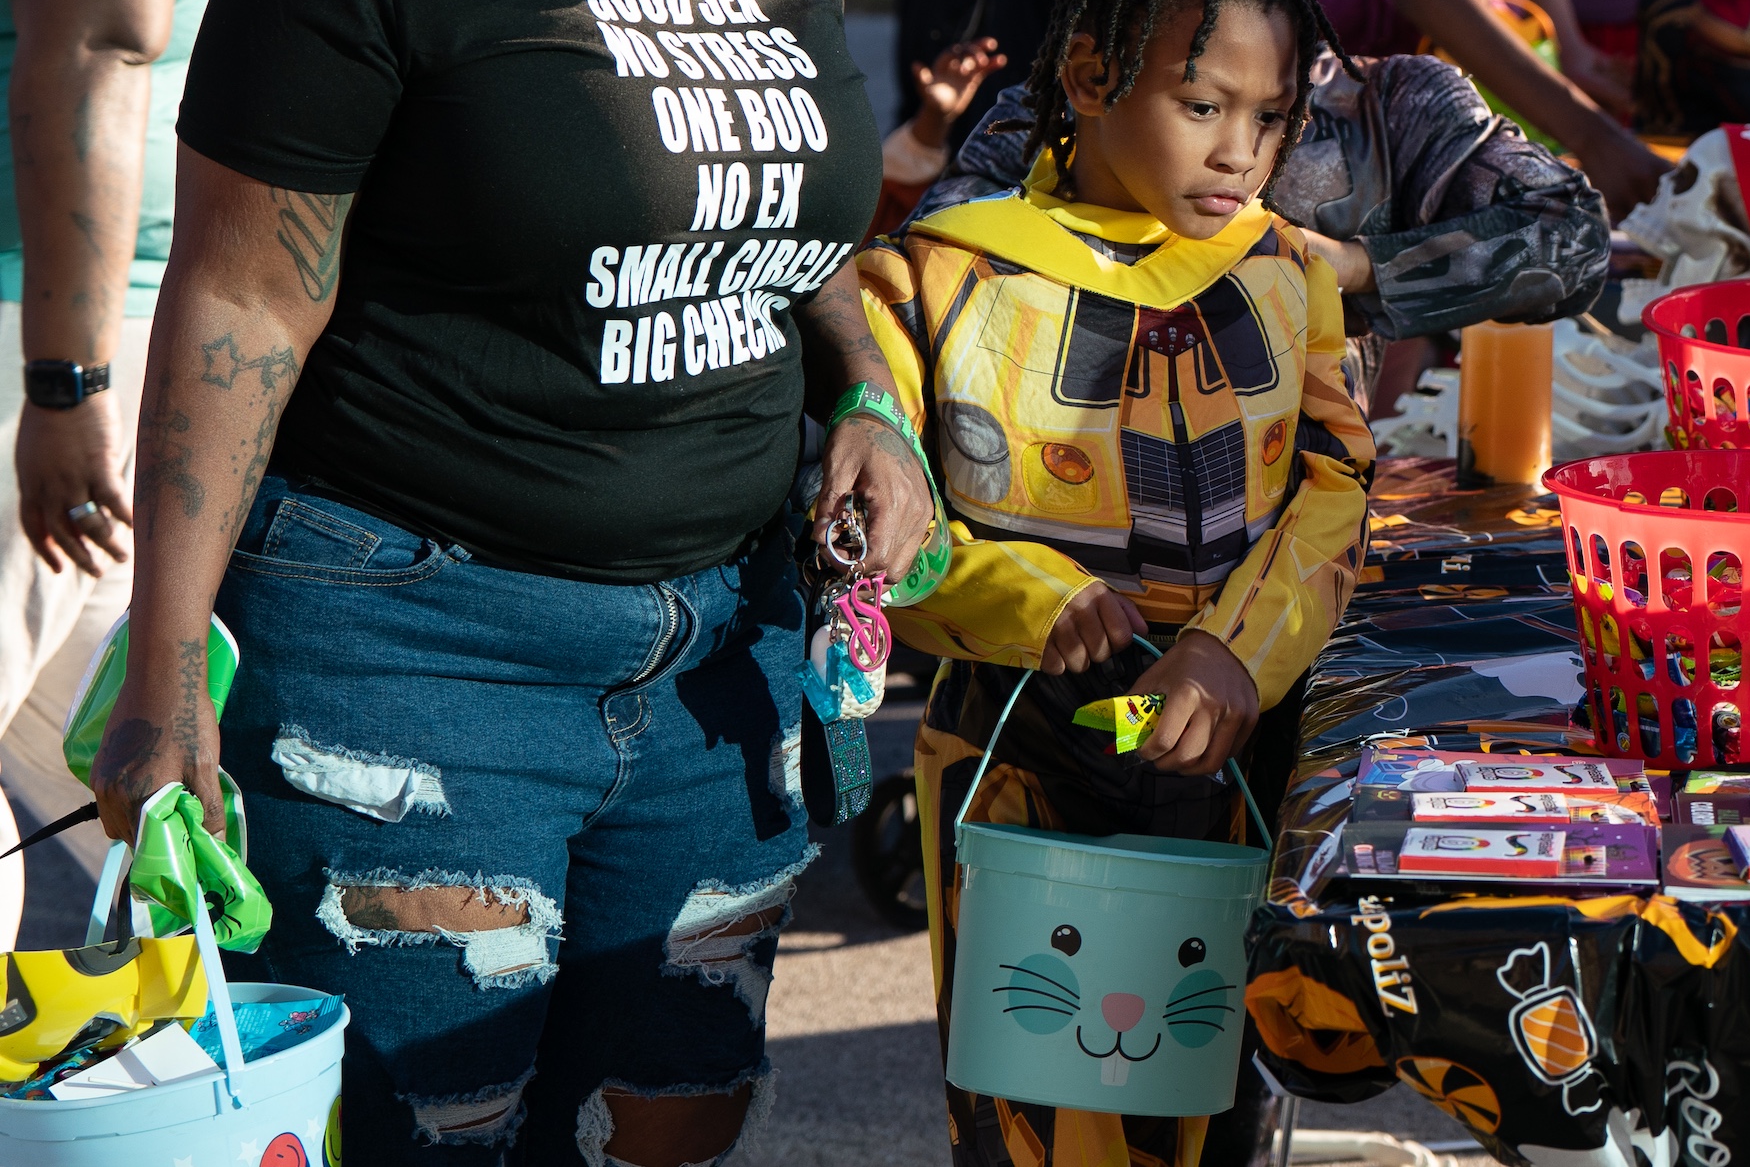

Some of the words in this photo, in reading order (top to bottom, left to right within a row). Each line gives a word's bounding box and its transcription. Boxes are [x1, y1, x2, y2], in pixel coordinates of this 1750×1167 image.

[597, 20, 671, 78] NO
[656, 26, 818, 82] STRESS
[651, 85, 741, 155] ONE
[738, 86, 829, 154] BOO
[689, 161, 751, 233] NO
[752, 162, 804, 231] EX
[586, 242, 727, 310] SMALL
[717, 238, 854, 296] CIRCLE
[600, 311, 677, 386] BIG
